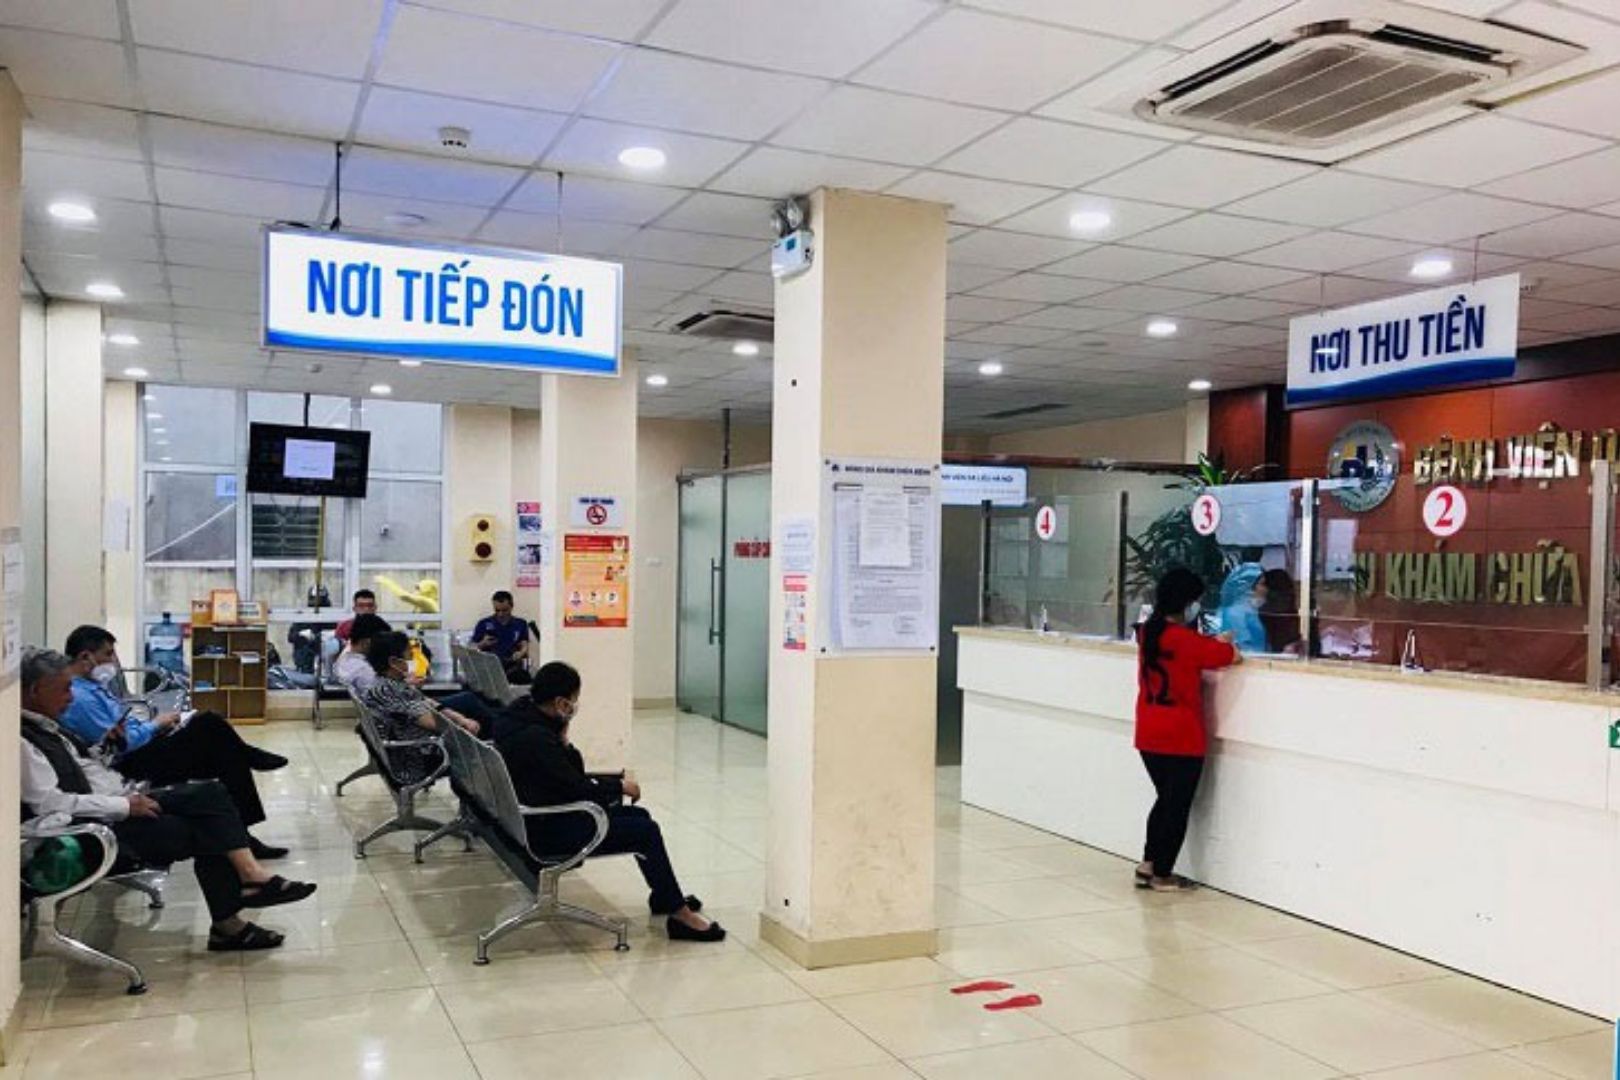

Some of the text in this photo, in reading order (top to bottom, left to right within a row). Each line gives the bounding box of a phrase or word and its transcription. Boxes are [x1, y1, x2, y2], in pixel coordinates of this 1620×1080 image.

[307, 258, 584, 338] NƠI TIẾP ĐÓN
[1310, 294, 1486, 374] NƠI THU TIỀN
[1507, 422, 1583, 490] VIỆN
[1040, 510, 1050, 534] 4
[1199, 501, 1212, 529] 3
[1434, 491, 1454, 527] 2
